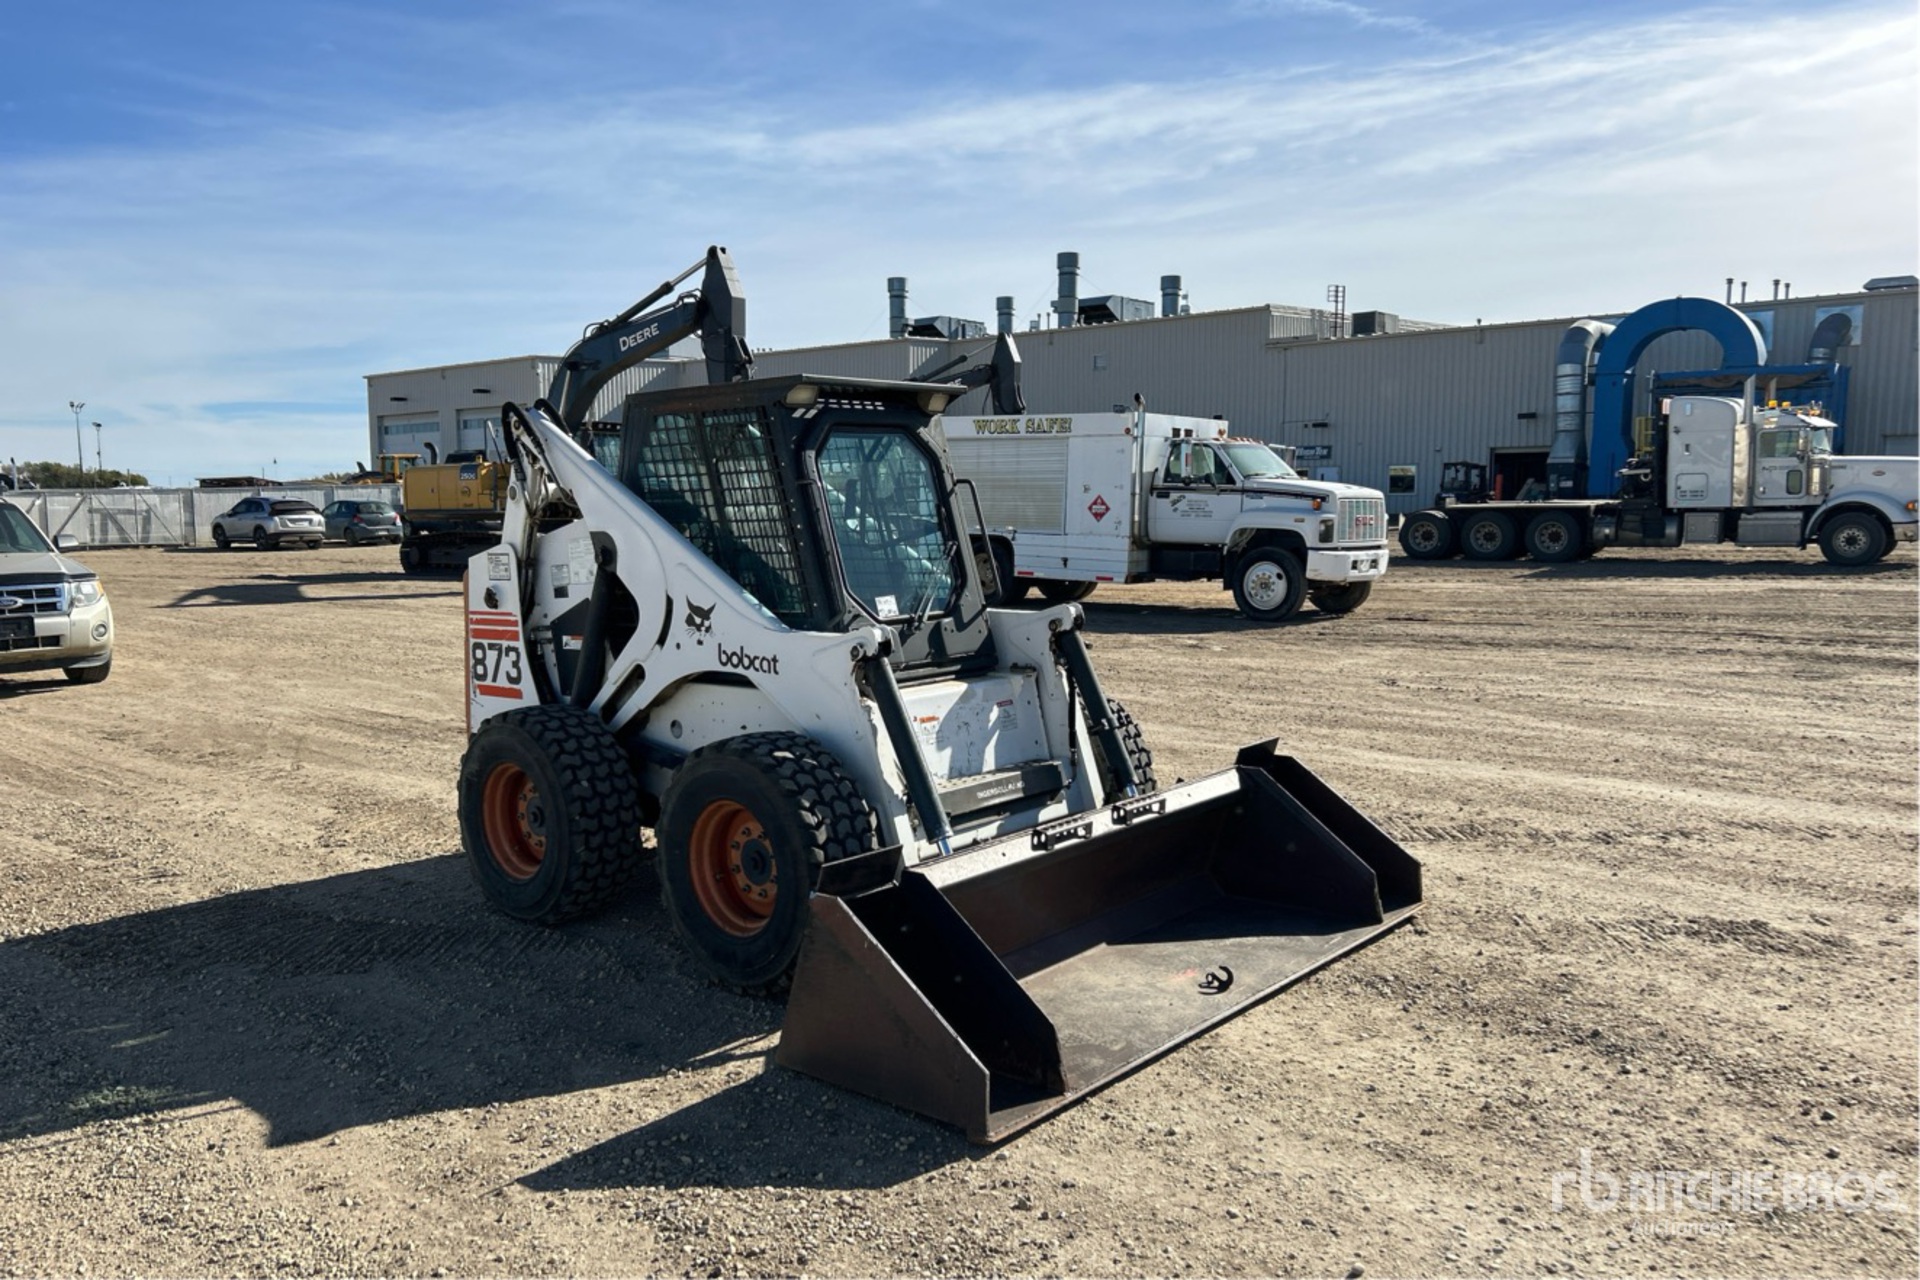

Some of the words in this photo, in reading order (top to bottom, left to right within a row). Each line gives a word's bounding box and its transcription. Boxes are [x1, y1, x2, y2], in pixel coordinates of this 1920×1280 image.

[619, 322, 660, 352] DEERE
[973, 418, 1021, 435] WORK
[471, 641, 522, 686] 873
[717, 642, 779, 676] bobcat
